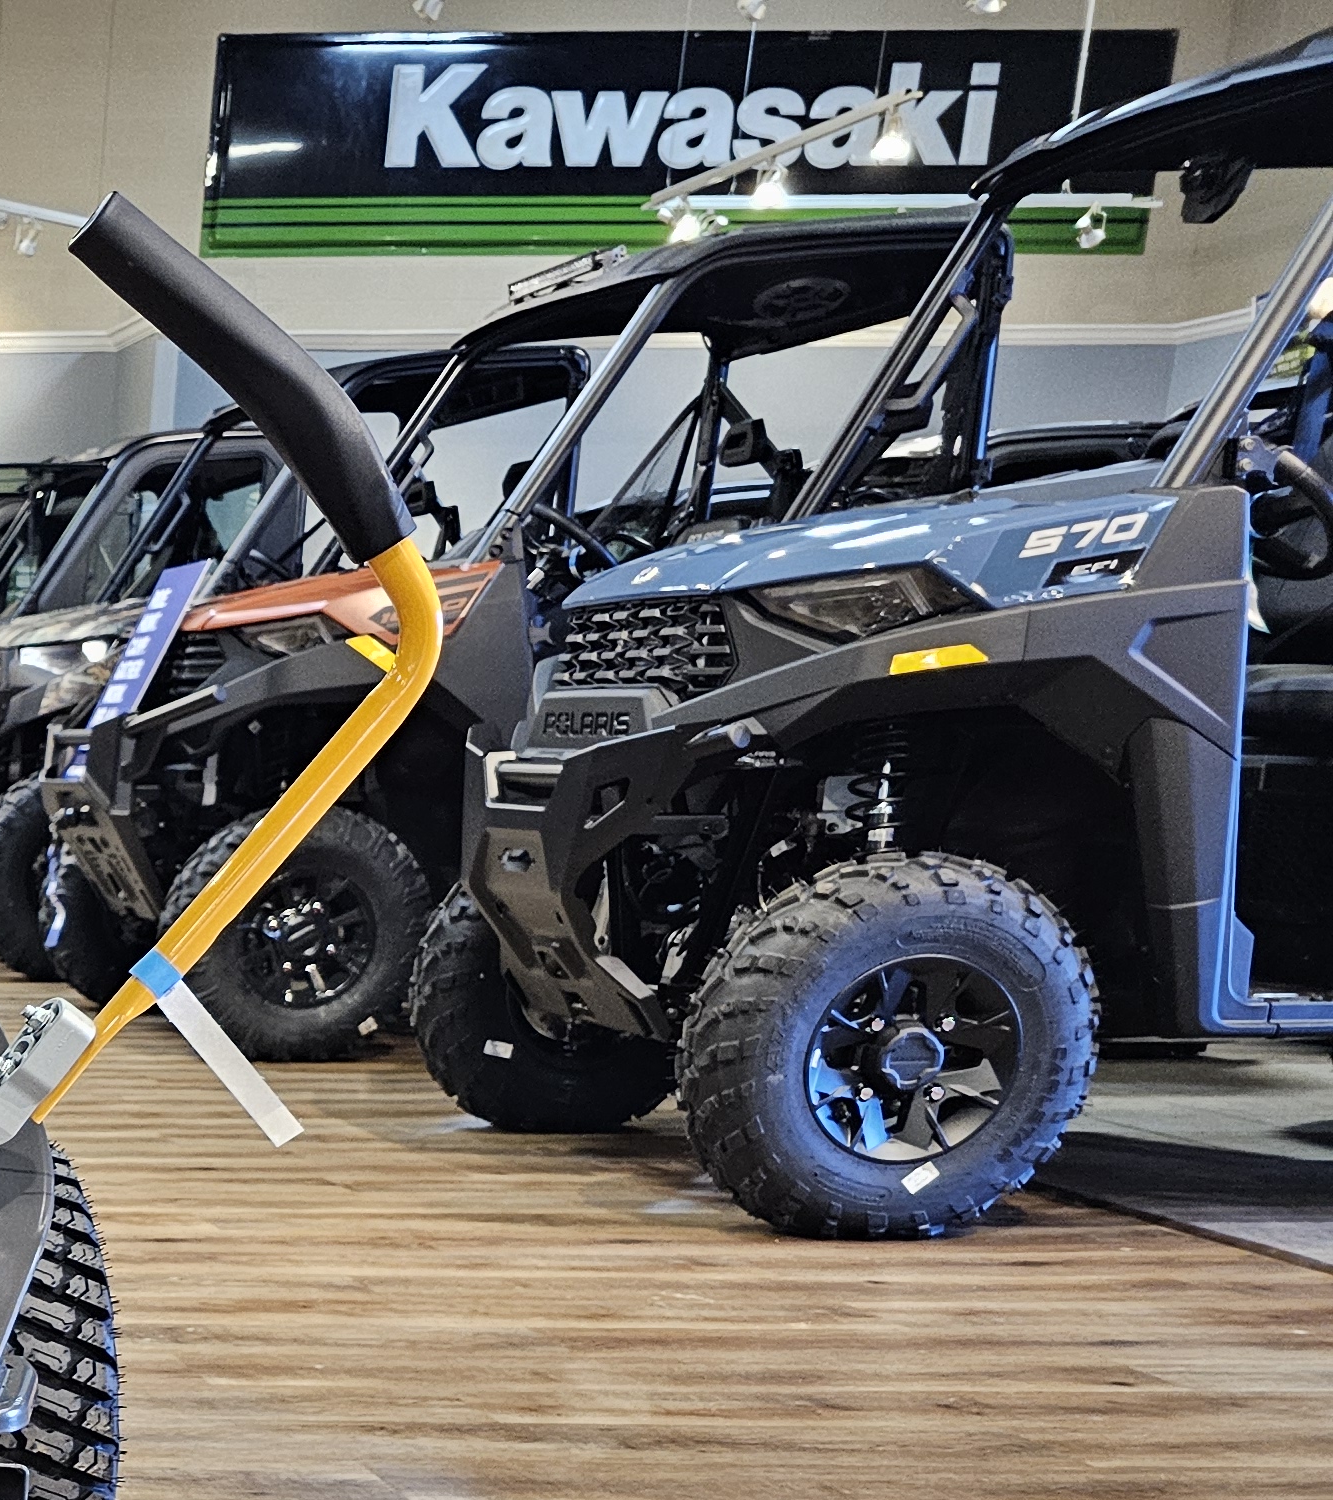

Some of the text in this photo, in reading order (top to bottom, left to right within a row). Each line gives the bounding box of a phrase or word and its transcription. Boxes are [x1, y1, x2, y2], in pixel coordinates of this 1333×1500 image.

[384, 61, 1001, 170] Kawasaki
[1018, 511, 1149, 558] 570
[1070, 558, 1119, 576] EFI
[542, 711, 630, 736] POLARIS
